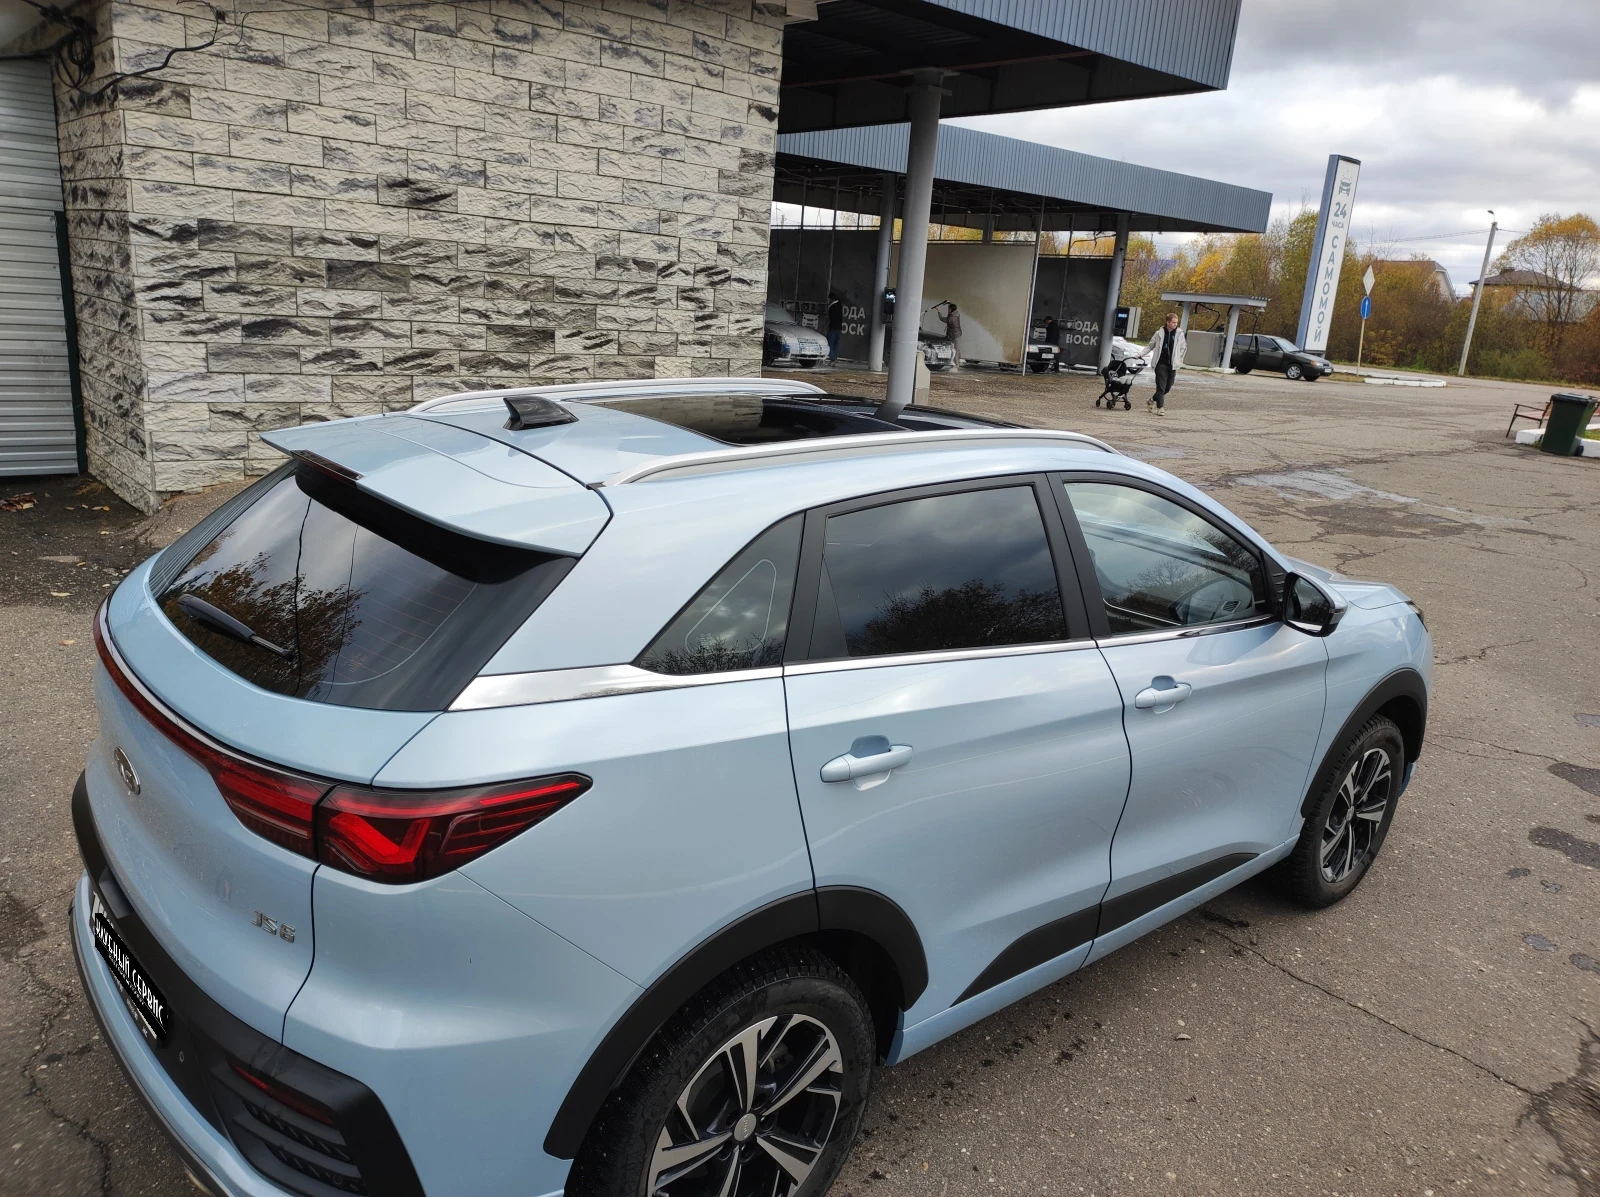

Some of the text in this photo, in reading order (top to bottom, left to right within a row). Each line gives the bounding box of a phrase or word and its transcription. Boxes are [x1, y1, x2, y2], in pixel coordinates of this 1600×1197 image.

[1333, 202, 1347, 218] 24
[1331, 221, 1344, 229] ЧАСА
[1313, 235, 1339, 342] САМОМОЙ
[842, 306, 866, 321] ОДА
[841, 322, 865, 336] ОСК
[1072, 320, 1099, 333] ОДА
[250, 909, 296, 943] JS6
